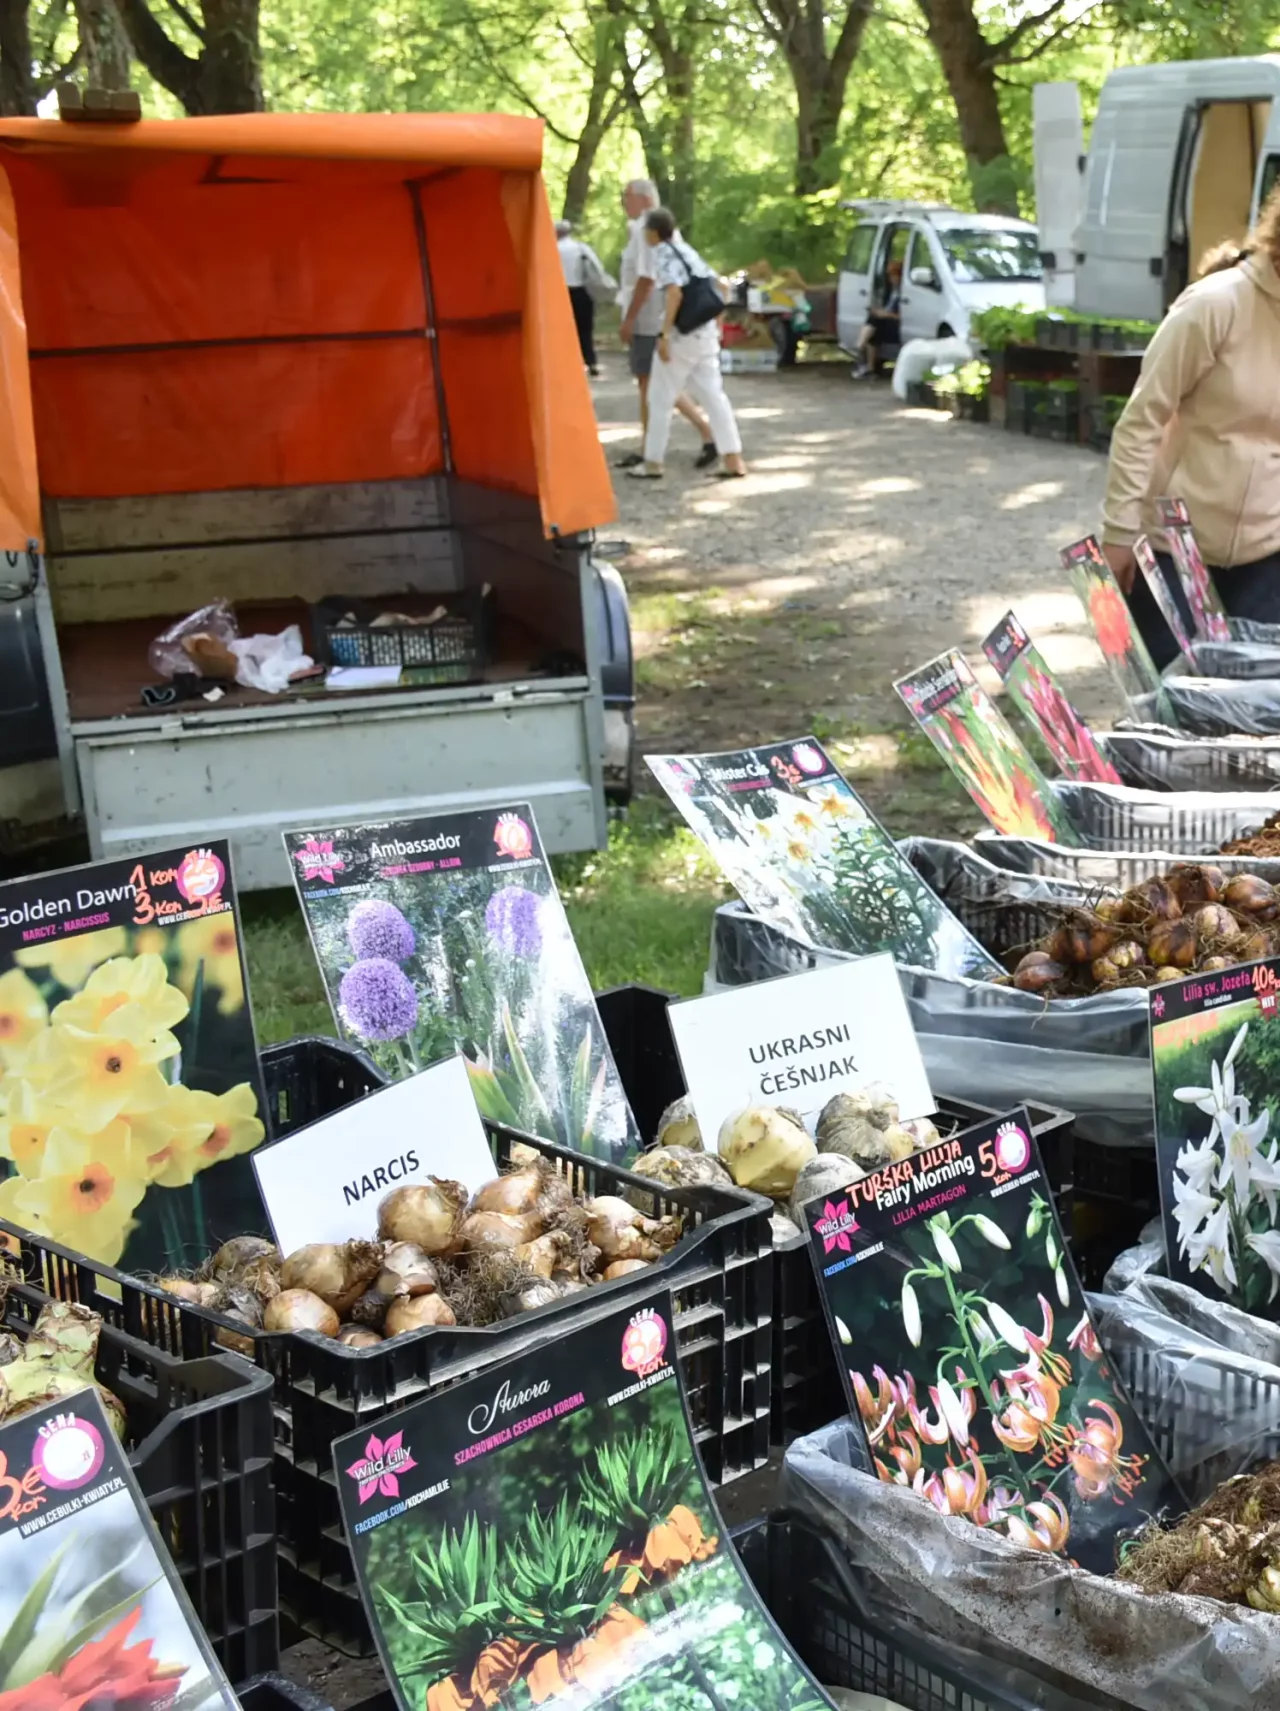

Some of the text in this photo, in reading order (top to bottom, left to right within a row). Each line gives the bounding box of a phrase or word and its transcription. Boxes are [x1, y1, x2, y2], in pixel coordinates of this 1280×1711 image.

[370, 833, 461, 859] Ambassador
[130, 864, 148, 893] 1
[0, 884, 138, 929] Golden Dawn
[132, 891, 155, 925] 3
[22, 924, 57, 942] NARCYZ
[64, 912, 111, 932] NARCISSUS
[1183, 984, 1204, 1003] Lilia
[1251, 964, 1275, 991] 10€
[1261, 995, 1276, 1009] HIT
[748, 1024, 851, 1064] UKRASNI
[759, 1055, 859, 1096] ČEŠNJAK
[997, 1121, 1017, 1137] CENA
[342, 1150, 420, 1207] NARCIS
[845, 1161, 914, 1209] TURŠKA
[875, 1154, 976, 1211] Fairy Morning
[892, 1184, 967, 1226] LILIA MARTAGON
[818, 1220, 839, 1236] Wild
[839, 1212, 856, 1229] Lilly
[629, 1307, 656, 1327] CENA
[467, 1379, 551, 1435] Aurora
[37, 1411, 77, 1439] CENA
[454, 1391, 585, 1466] SZACHOWNICA CESARSKA KORONA
[353, 1457, 386, 1481] Wild
[386, 1446, 412, 1467] Lilly
[20, 1476, 127, 1537] WWW.CEBULKI-KWIATY.PL
[354, 1478, 451, 1536] FACEBOOK.COM/KOCHAMLILIE
